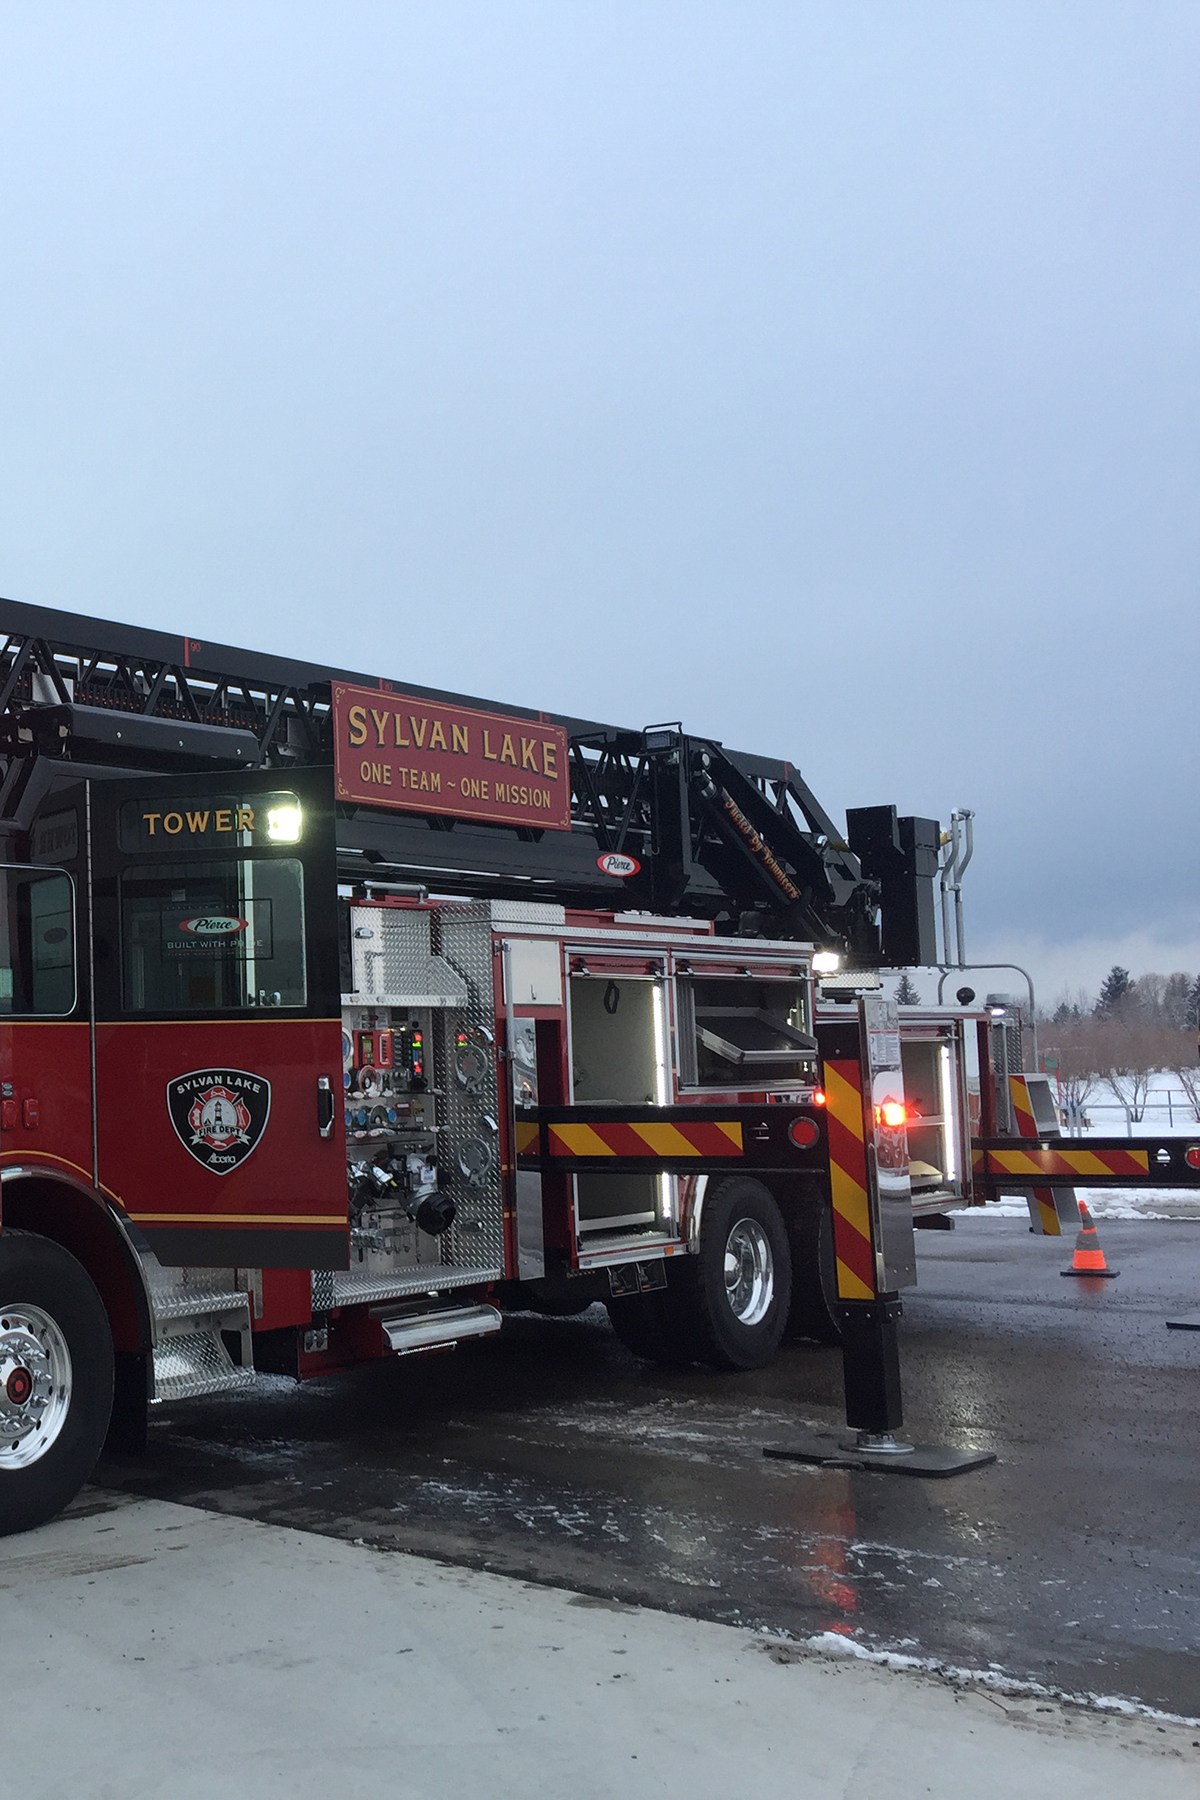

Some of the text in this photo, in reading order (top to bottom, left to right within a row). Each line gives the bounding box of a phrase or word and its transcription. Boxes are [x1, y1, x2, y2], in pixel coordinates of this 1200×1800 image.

[349, 705, 558, 779] SYLVAN LAKE
[360, 761, 392, 785] ONE
[400, 767, 441, 793] TEAM
[461, 777, 489, 800] ONE
[495, 783, 551, 809] MISSION
[142, 809, 256, 836] TOWER
[607, 856, 631, 871] Pierce
[194, 918, 232, 931] Pierce
[167, 941, 197, 949] BUILT
[199, 940, 226, 948] WITH
[176, 1075, 261, 1094] SYLVAN LAKE
[199, 1125, 219, 1136] FIRE
